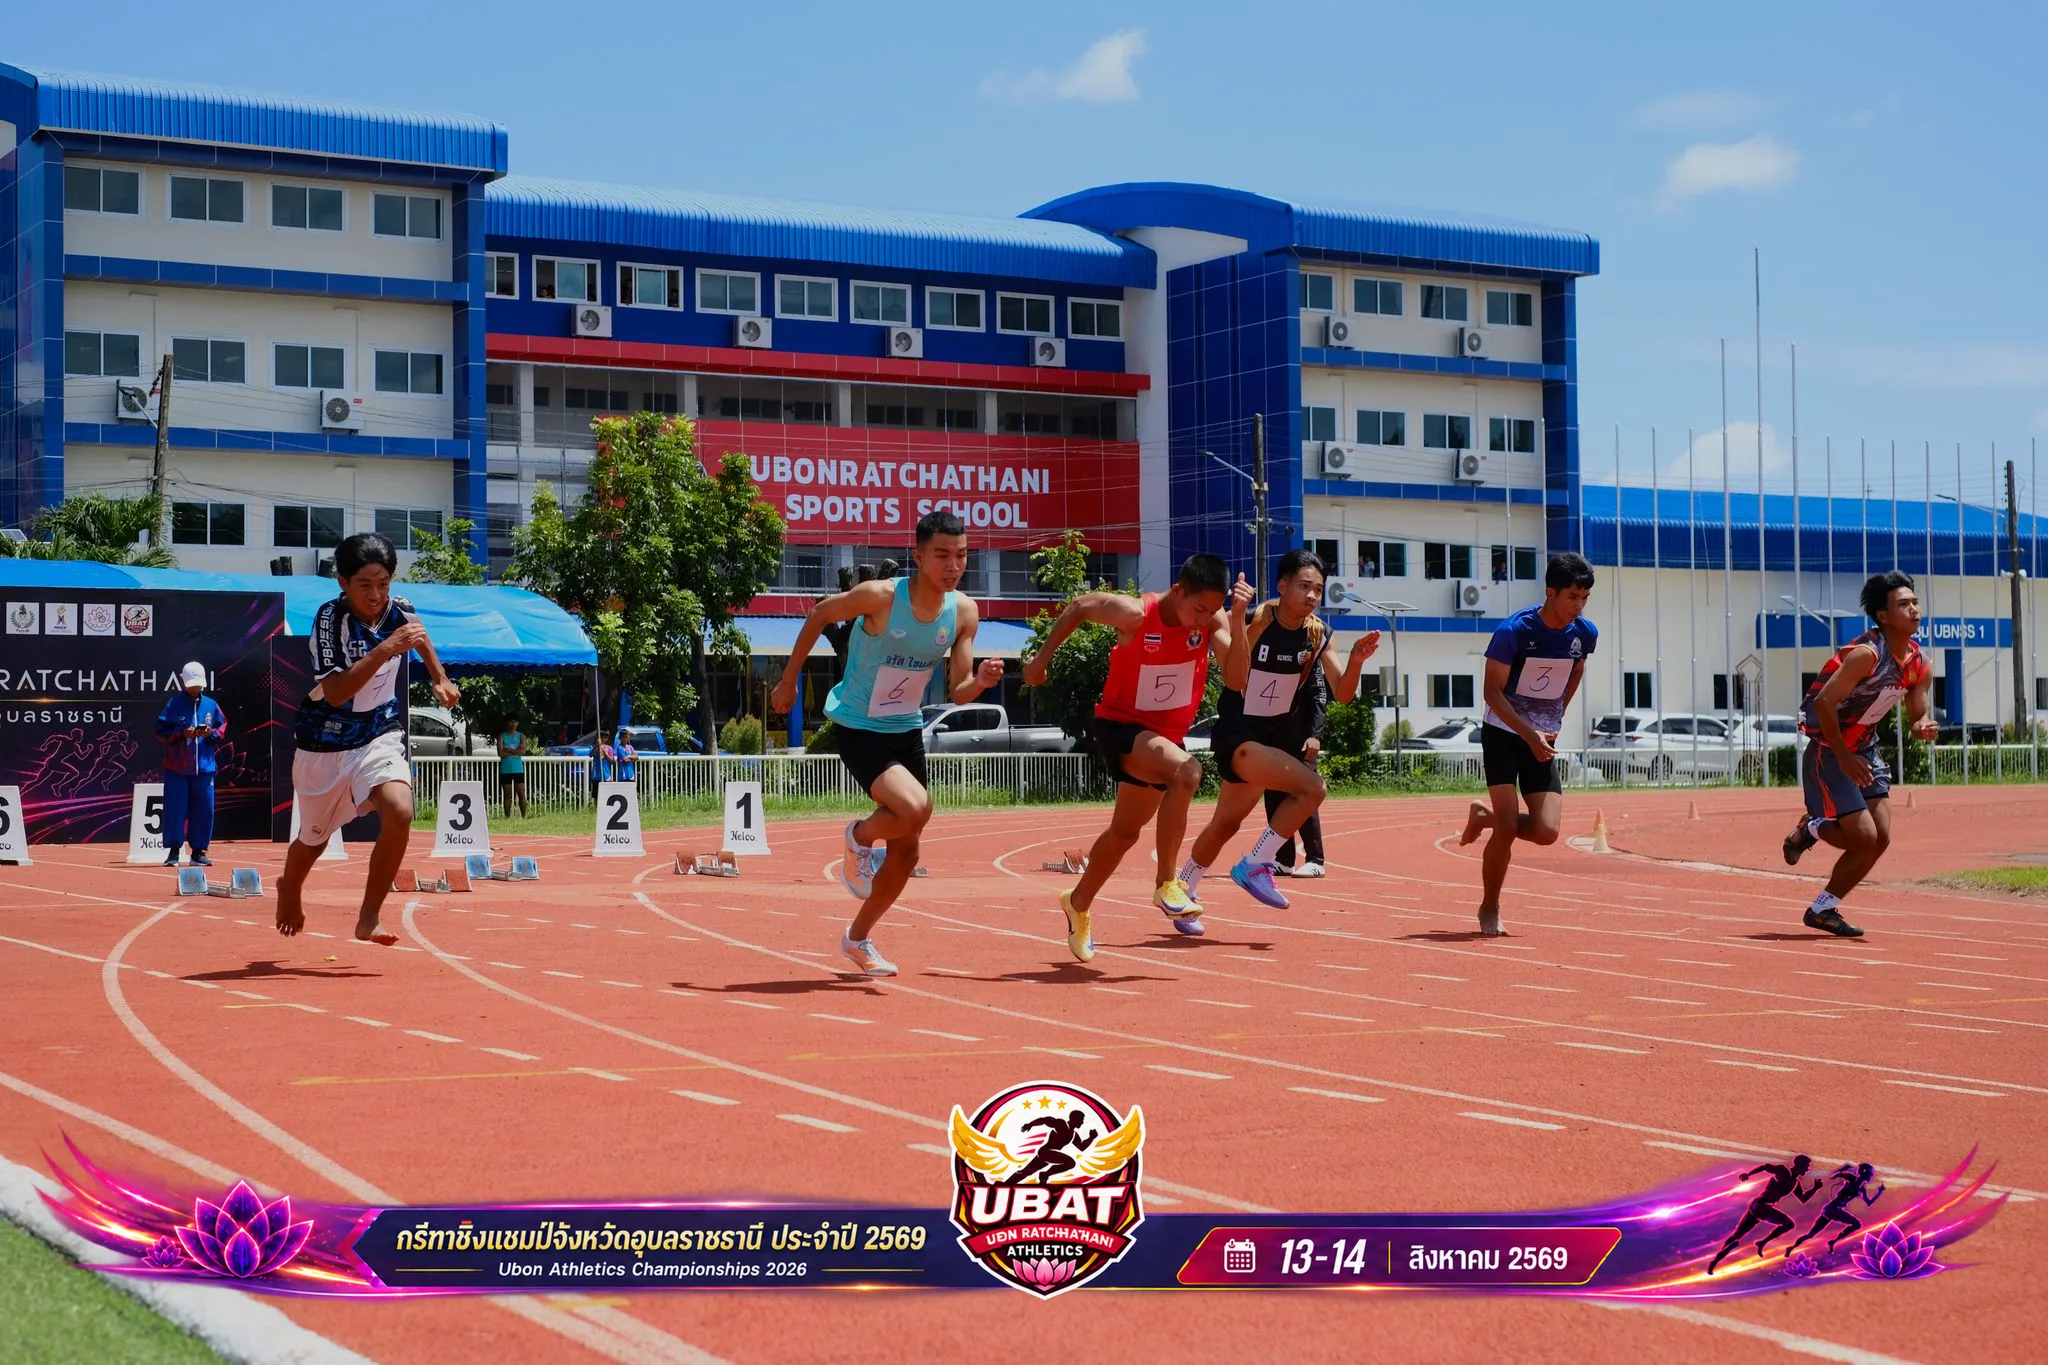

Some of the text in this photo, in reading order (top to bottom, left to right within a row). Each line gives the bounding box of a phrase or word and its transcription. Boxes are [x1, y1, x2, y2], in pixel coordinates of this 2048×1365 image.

[750, 454, 1049, 494] UBONRATCHATHANI
[786, 494, 900, 523] SPORTS
[1934, 624, 1975, 639] UBNSS
[1979, 625, 1985, 639] 1
[0, 669, 215, 691] RATCHATHAI
[374, 669, 391, 700] 7
[888, 677, 910, 700] 6
[1154, 674, 1178, 703] 5
[1260, 679, 1280, 707] 4
[1529, 666, 1553, 692] 3
[0, 706, 122, 726] บลราชธานี
[144, 795, 164, 834] 5
[449, 793, 473, 831] 3
[606, 794, 629, 830] 2
[736, 793, 752, 829] 1
[140, 837, 163, 849] Nelc
